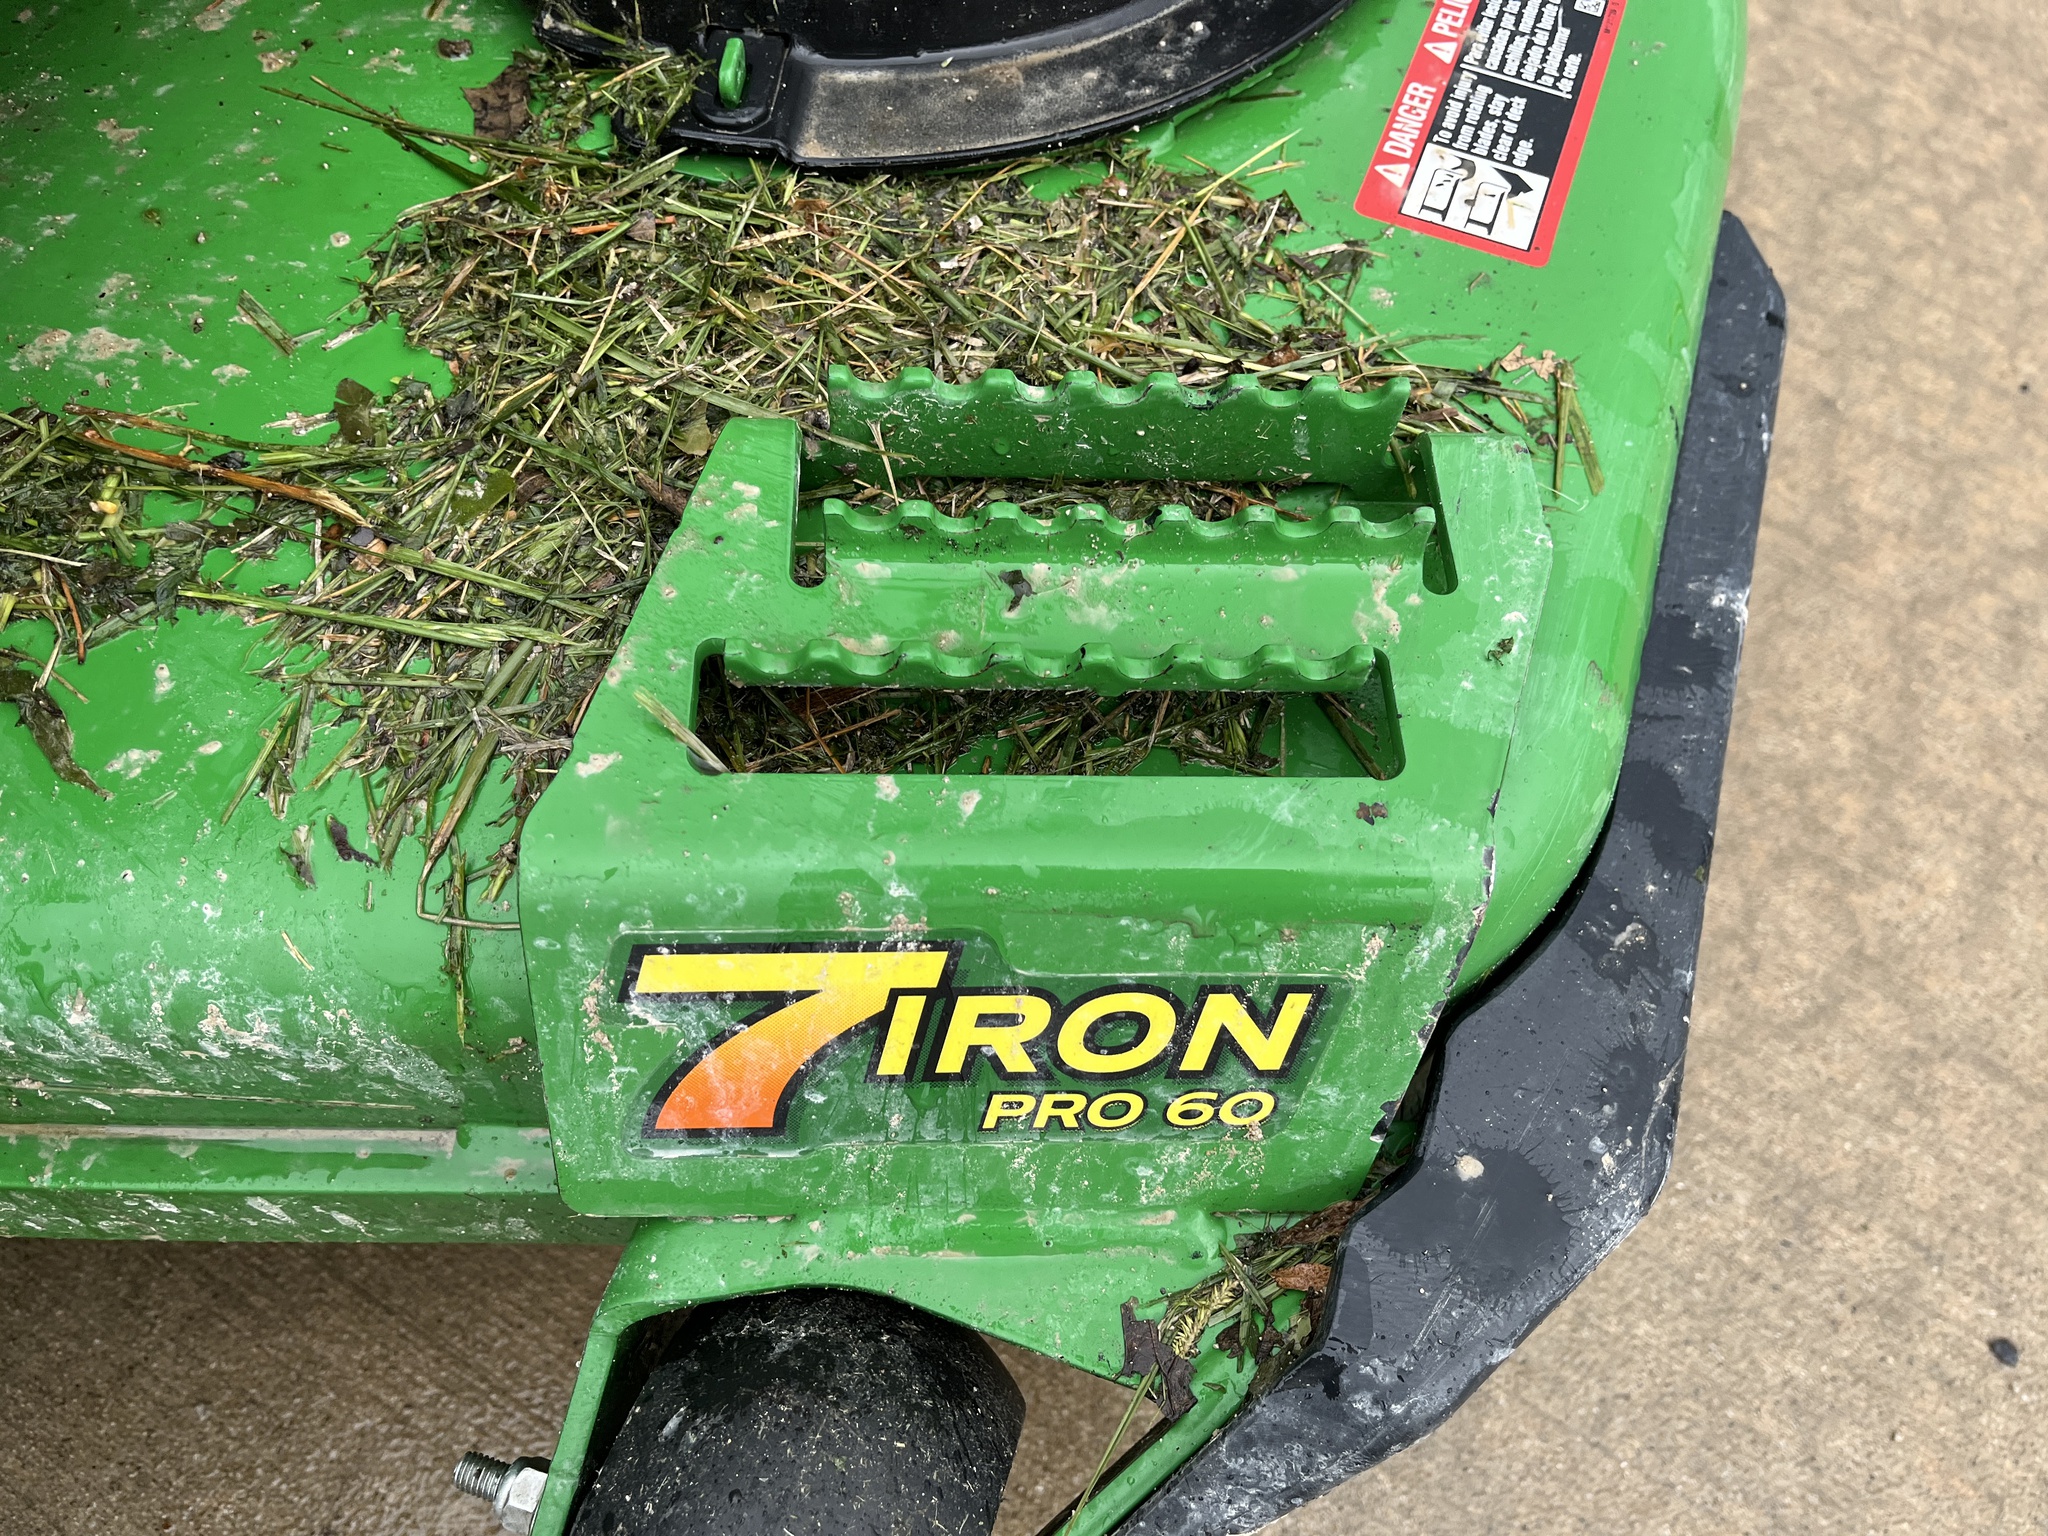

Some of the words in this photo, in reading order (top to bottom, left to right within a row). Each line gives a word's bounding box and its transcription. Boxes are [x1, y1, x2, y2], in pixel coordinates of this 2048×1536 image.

[1463, 42, 1486, 65] Para
[1481, 0, 1503, 19] lesi
[1500, 12, 1517, 31] por
[1450, 70, 1478, 101] injury
[1556, 77, 1574, 92] de
[1383, 82, 1437, 159] DANGER
[1442, 99, 1464, 130] avoid
[1452, 125, 1475, 151] from
[1464, 84, 1493, 125] rotating
[1504, 95, 1527, 122] deck
[1432, 130, 1453, 144] To
[1470, 119, 1501, 157] blades,
[1487, 93, 1510, 117] stay
[1501, 120, 1519, 134] of
[1491, 133, 1514, 162] clear
[1512, 138, 1534, 168] edge.
[634, 950, 950, 1130] 7
[874, 991, 1314, 1077] IRON
[980, 1091, 1147, 1130] PRO
[1170, 1091, 1276, 1127] 60
